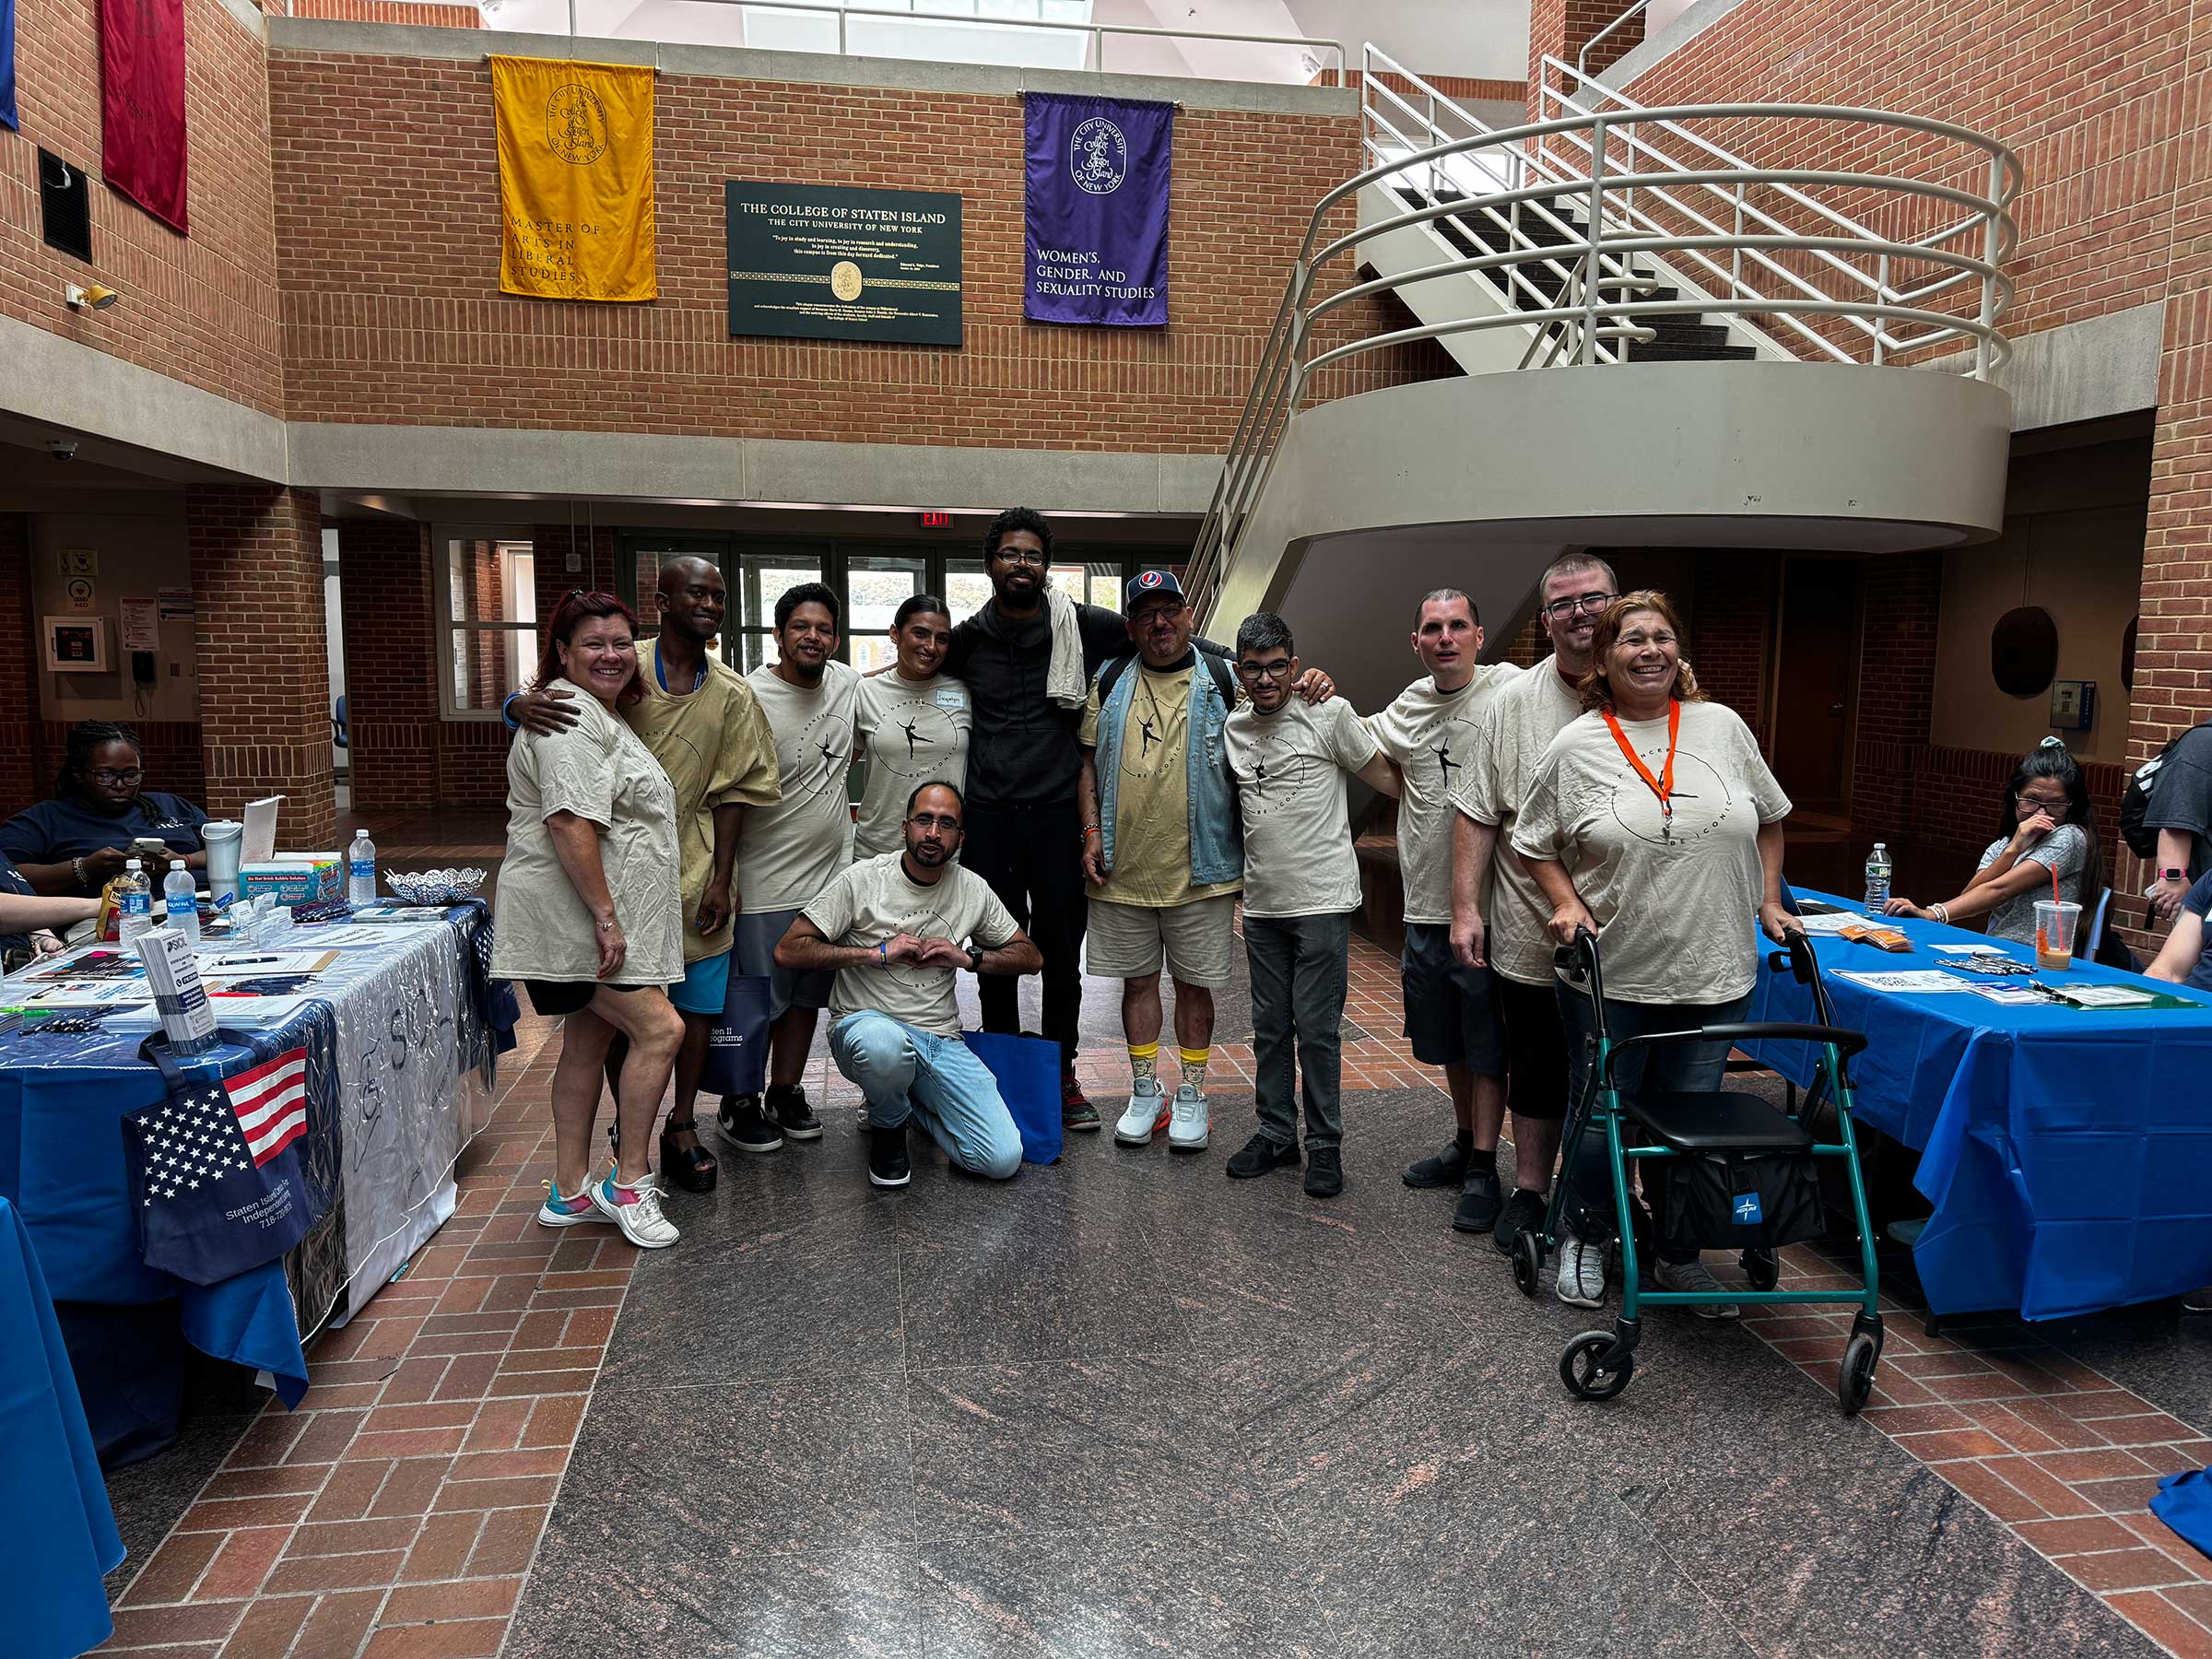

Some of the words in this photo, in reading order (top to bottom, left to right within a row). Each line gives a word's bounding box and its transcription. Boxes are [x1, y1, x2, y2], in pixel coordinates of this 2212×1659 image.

[1074, 135, 1083, 151] THE
[1079, 122, 1094, 135] CITY
[1095, 120, 1124, 156] UNIVERSITY
[551, 137, 562, 149] OF
[560, 149, 581, 161] NEW
[584, 144, 605, 160] YORK
[1075, 170, 1086, 182] OF
[1082, 180, 1102, 191] NEW
[1104, 173, 1122, 190] YORK
[741, 203, 768, 214] THE
[771, 205, 829, 218] COLLEGE
[831, 208, 848, 218] OF
[851, 209, 898, 222] STATEN
[901, 212, 946, 223] ISLAND
[511, 217, 573, 233] MASTER
[581, 224, 600, 235] OF
[789, 219, 809, 228] CITY
[812, 221, 863, 230] UNIVERSITY
[900, 226, 923, 234] YORK
[512, 234, 550, 249] ARTS
[559, 240, 575, 250] IN
[512, 250, 574, 265] LIBERAL
[511, 266, 576, 281] STUDIES
[1098, 269, 1125, 283] AND
[1037, 281, 1101, 296] SEXUALITY
[1105, 286, 1155, 299] STUDIES
[1425, 716, 1458, 733] DANCER
[1154, 746, 1181, 775] ICONIC
[1626, 747, 1671, 768] DNCER
[1670, 838, 1686, 846] BE
[1696, 799, 1732, 839] ICONIC
[900, 909, 936, 921] DANCER
[225, 1202, 260, 1220] Staten
[260, 1191, 277, 1206] Island
